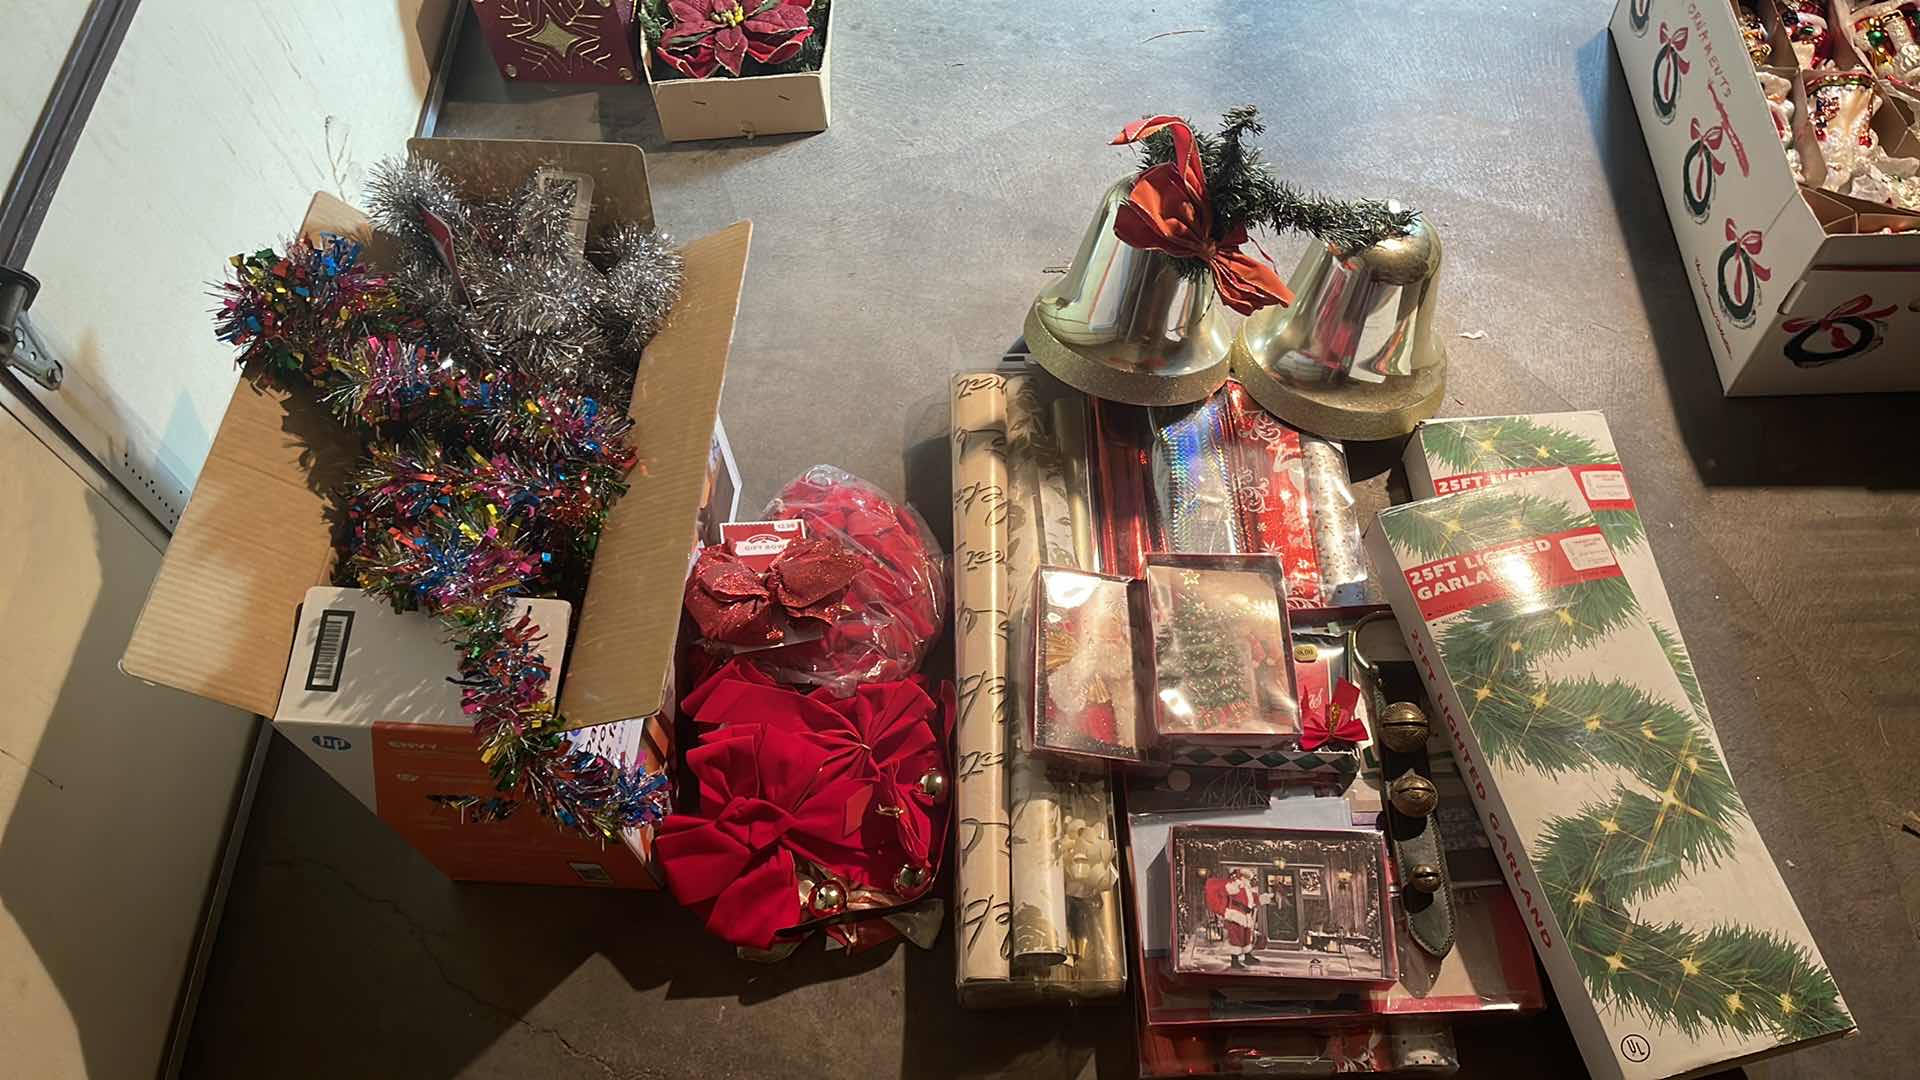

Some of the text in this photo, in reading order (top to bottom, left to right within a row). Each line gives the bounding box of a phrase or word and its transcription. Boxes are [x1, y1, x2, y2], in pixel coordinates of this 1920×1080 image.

[1437, 475, 1483, 493] 25FT
[1409, 560, 1457, 585] 25FT
[1411, 629, 1436, 681] 25FT
[1438, 692, 1487, 800] LIGHTED
[1489, 812, 1553, 949] GARLAND
